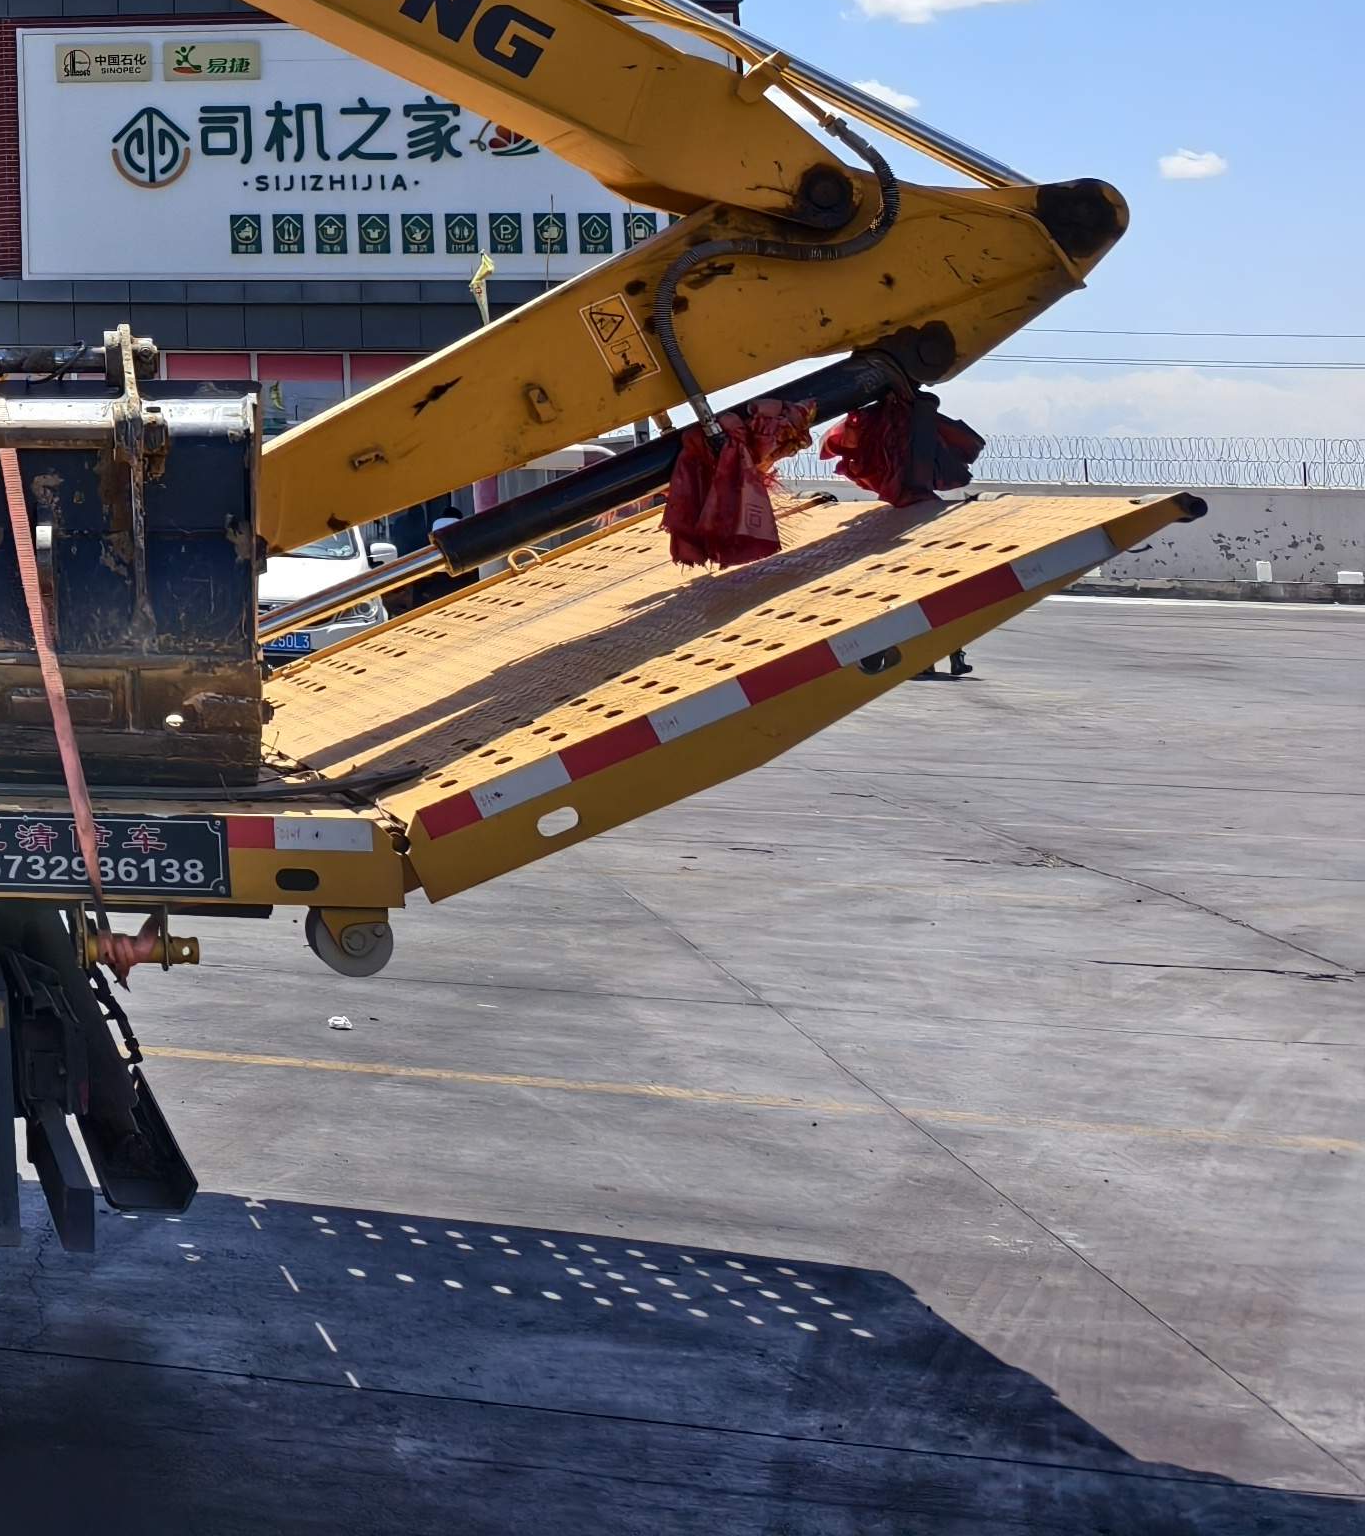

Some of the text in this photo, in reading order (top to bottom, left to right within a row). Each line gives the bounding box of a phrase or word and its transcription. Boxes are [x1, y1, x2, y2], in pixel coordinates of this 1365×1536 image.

[95, 54, 147, 66] 中国石化
[207, 58, 250, 74] 易捷
[199, 96, 462, 165] 司机之家
